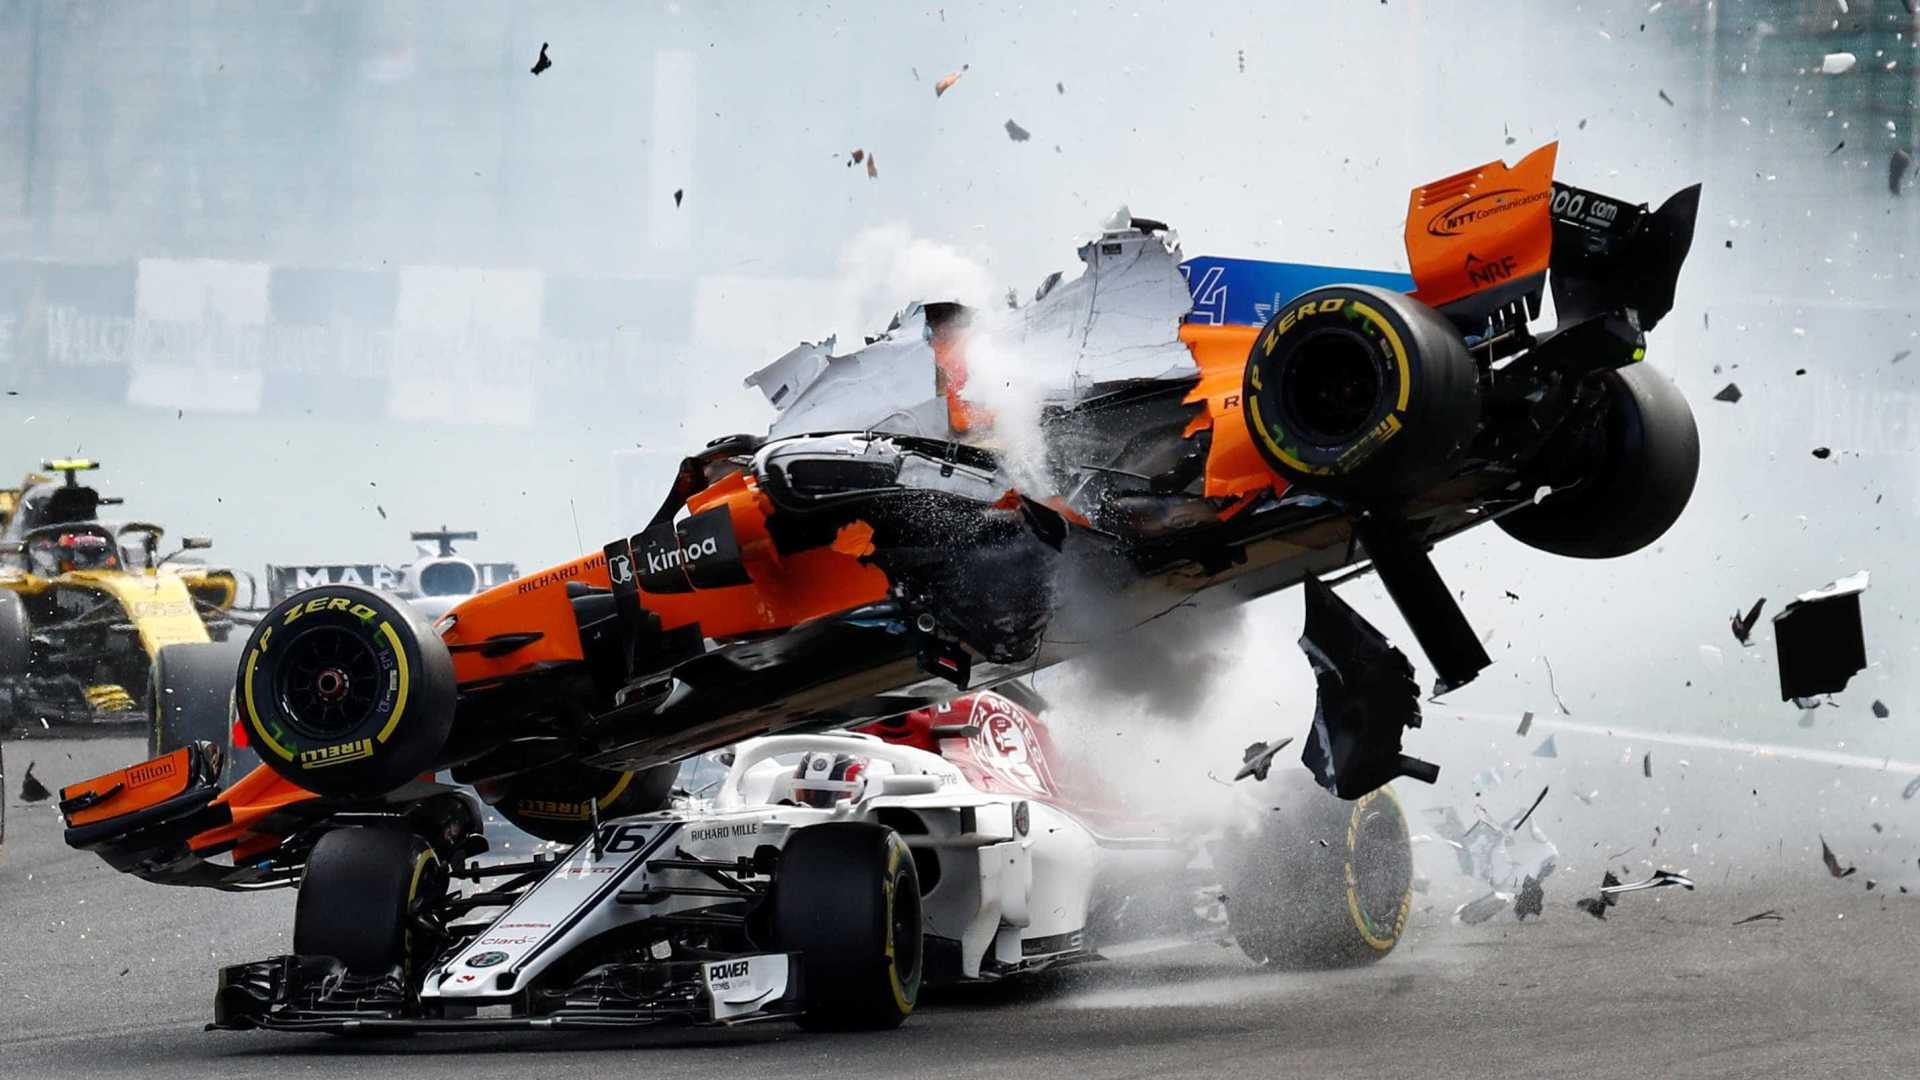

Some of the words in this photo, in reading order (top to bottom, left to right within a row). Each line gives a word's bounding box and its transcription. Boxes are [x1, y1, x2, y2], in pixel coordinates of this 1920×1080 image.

[1446, 209, 1477, 229] NTT
[1475, 192, 1550, 219] Communications
[1469, 255, 1517, 288] NRF
[1180, 265, 1228, 326] 4
[1251, 364, 1263, 391] P
[1262, 298, 1345, 357] ZERO
[646, 536, 717, 575] kimoa
[518, 564, 579, 594] RICHARD
[583, 554, 607, 571] MIL
[259, 625, 273, 653] P
[283, 597, 378, 626] ZERO
[300, 738, 374, 770] PIRELLI
[130, 763, 173, 785] Hilton
[594, 824, 651, 853] 16
[691, 830, 729, 841] RICHARD
[732, 823, 758, 836] MILLE
[481, 936, 528, 945] Claro
[709, 960, 750, 982] POWER
